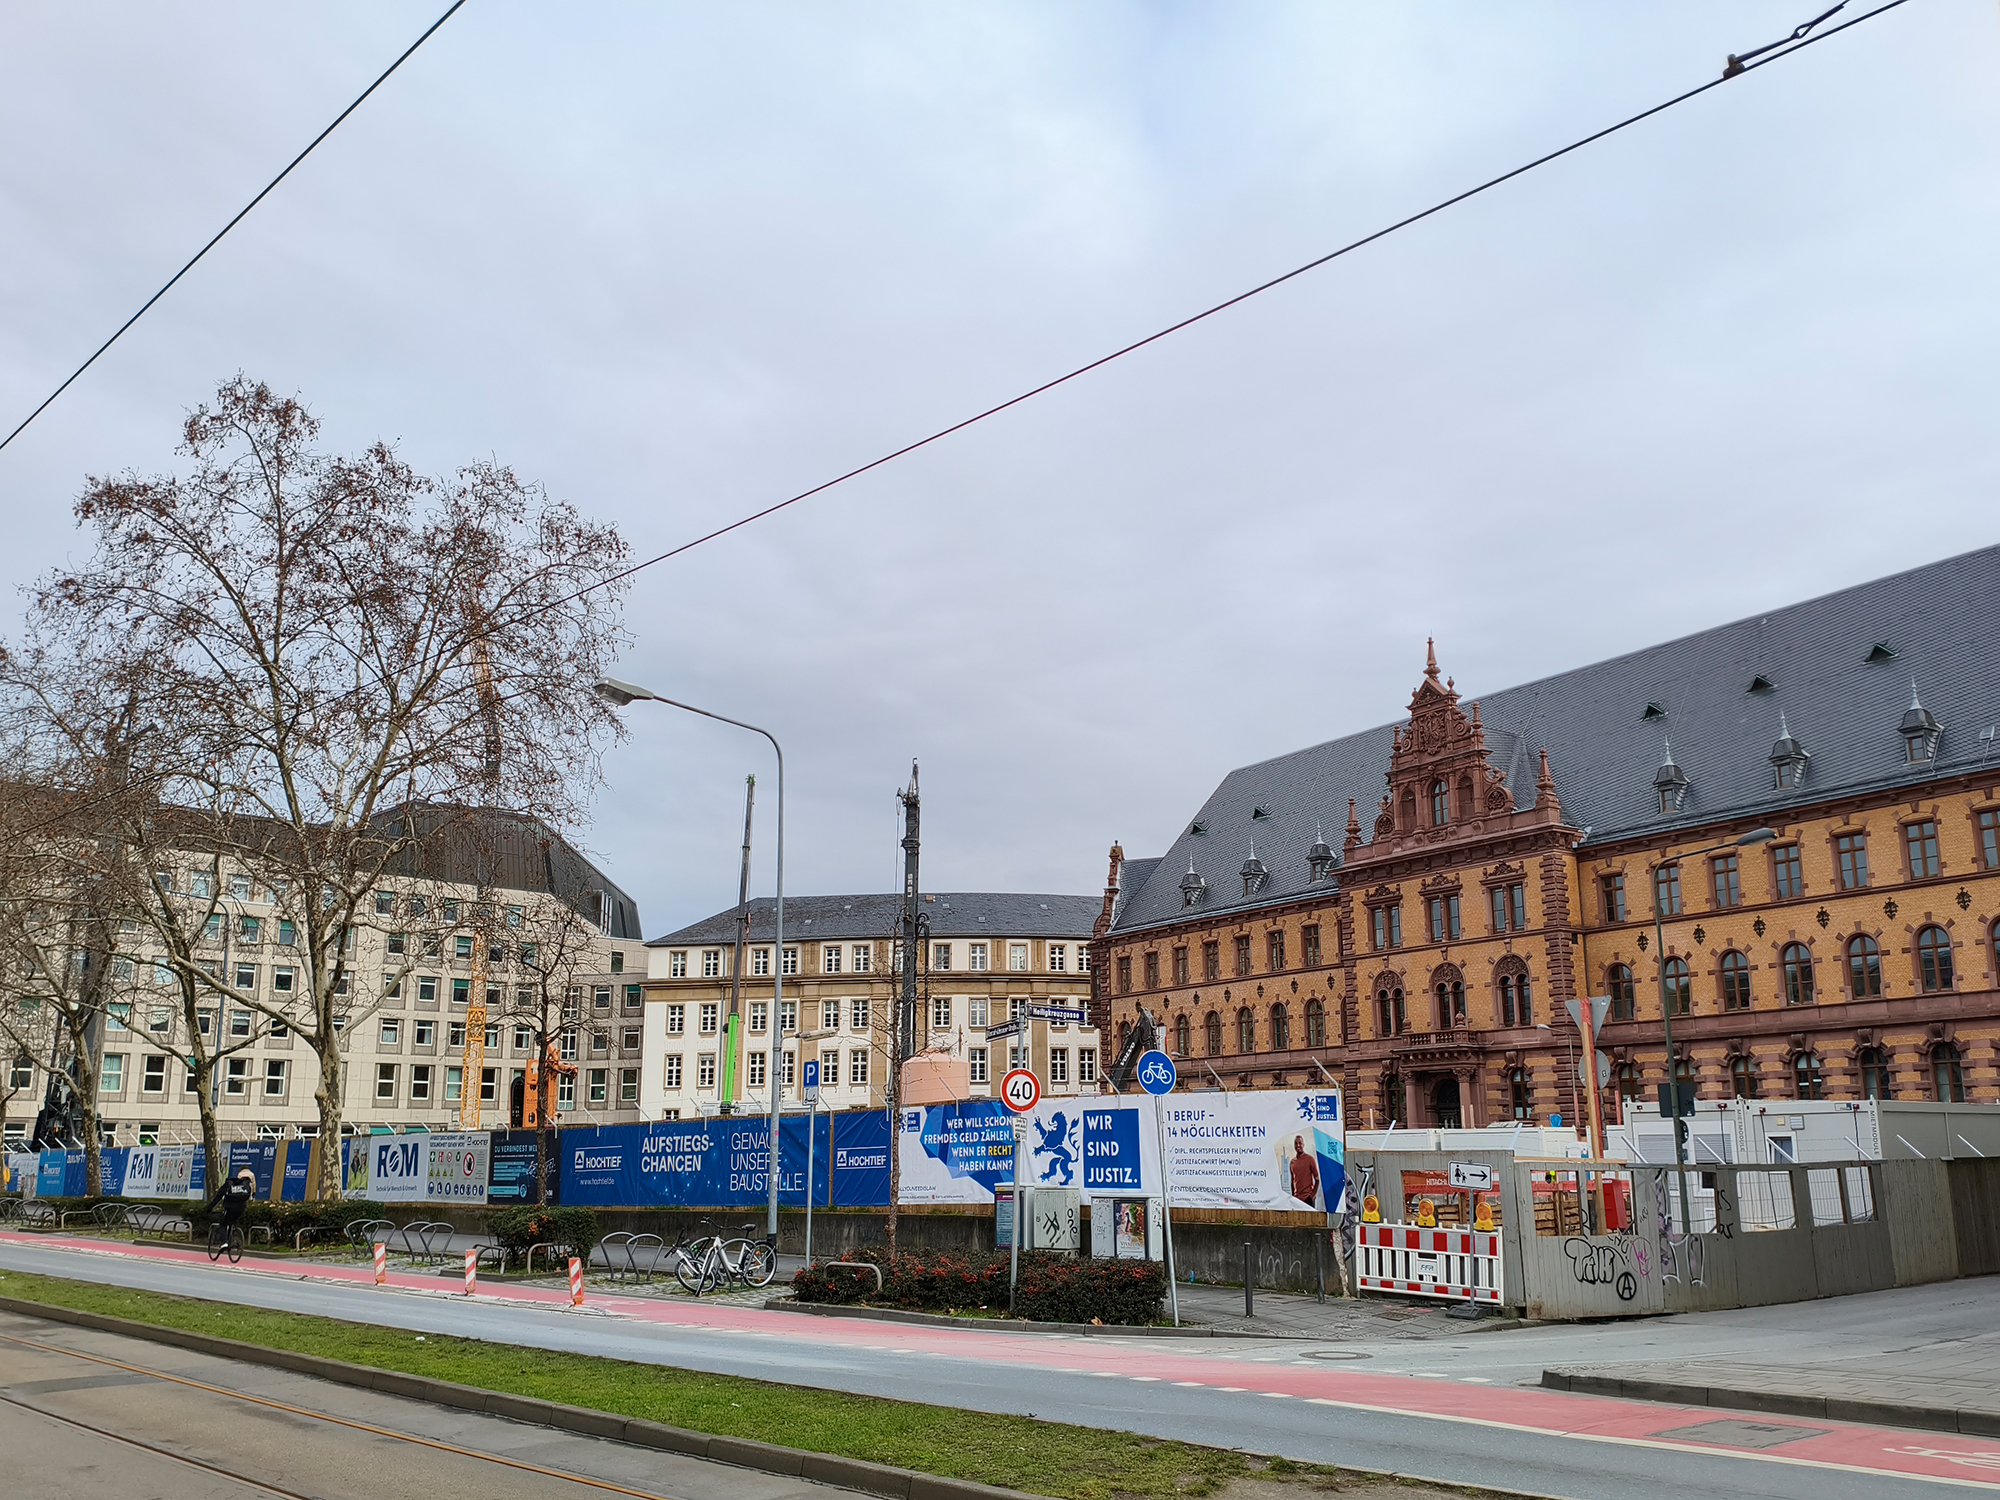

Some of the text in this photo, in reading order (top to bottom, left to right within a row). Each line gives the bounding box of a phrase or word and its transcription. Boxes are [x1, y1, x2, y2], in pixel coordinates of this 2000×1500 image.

[1032, 1008, 1080, 1019] Heiligkreuzgasse
[1120, 1042, 1136, 1066] VOLVO
[806, 1064, 816, 1084] P
[1010, 1080, 1032, 1100] 40
[946, 1119, 962, 1130] WER
[964, 1118, 983, 1128] WILL
[984, 1116, 1012, 1127] SCHON
[1086, 1114, 1113, 1130] WIR
[1174, 1110, 1206, 1122] BERUF
[924, 1133, 958, 1145] FREMDES
[959, 1132, 980, 1143] GELD
[980, 1130, 1012, 1142] ZÄHLEN,
[1166, 1124, 1266, 1138] 14 MÖGLICHKEITEN
[1736, 1108, 1746, 1153] MIETMODULE
[1870, 1110, 1880, 1156] MIETMODULE
[641, 1134, 714, 1154] AUFSTIEGS-
[952, 1146, 1013, 1158] WENN ER RECHT
[1087, 1140, 1120, 1157] SIND
[585, 1156, 622, 1168] HOCHTIEF
[641, 1155, 702, 1173] CHANCEN
[848, 1155, 887, 1167] HOCHTIEF
[959, 1160, 1014, 1172] HABEN KANN?
[1088, 1168, 1138, 1184] JUSTIZ.
[1175, 1169, 1243, 1177] JUSTIZFACHANGESTELLTER
[730, 1173, 805, 1192] BAUSTLLE.
